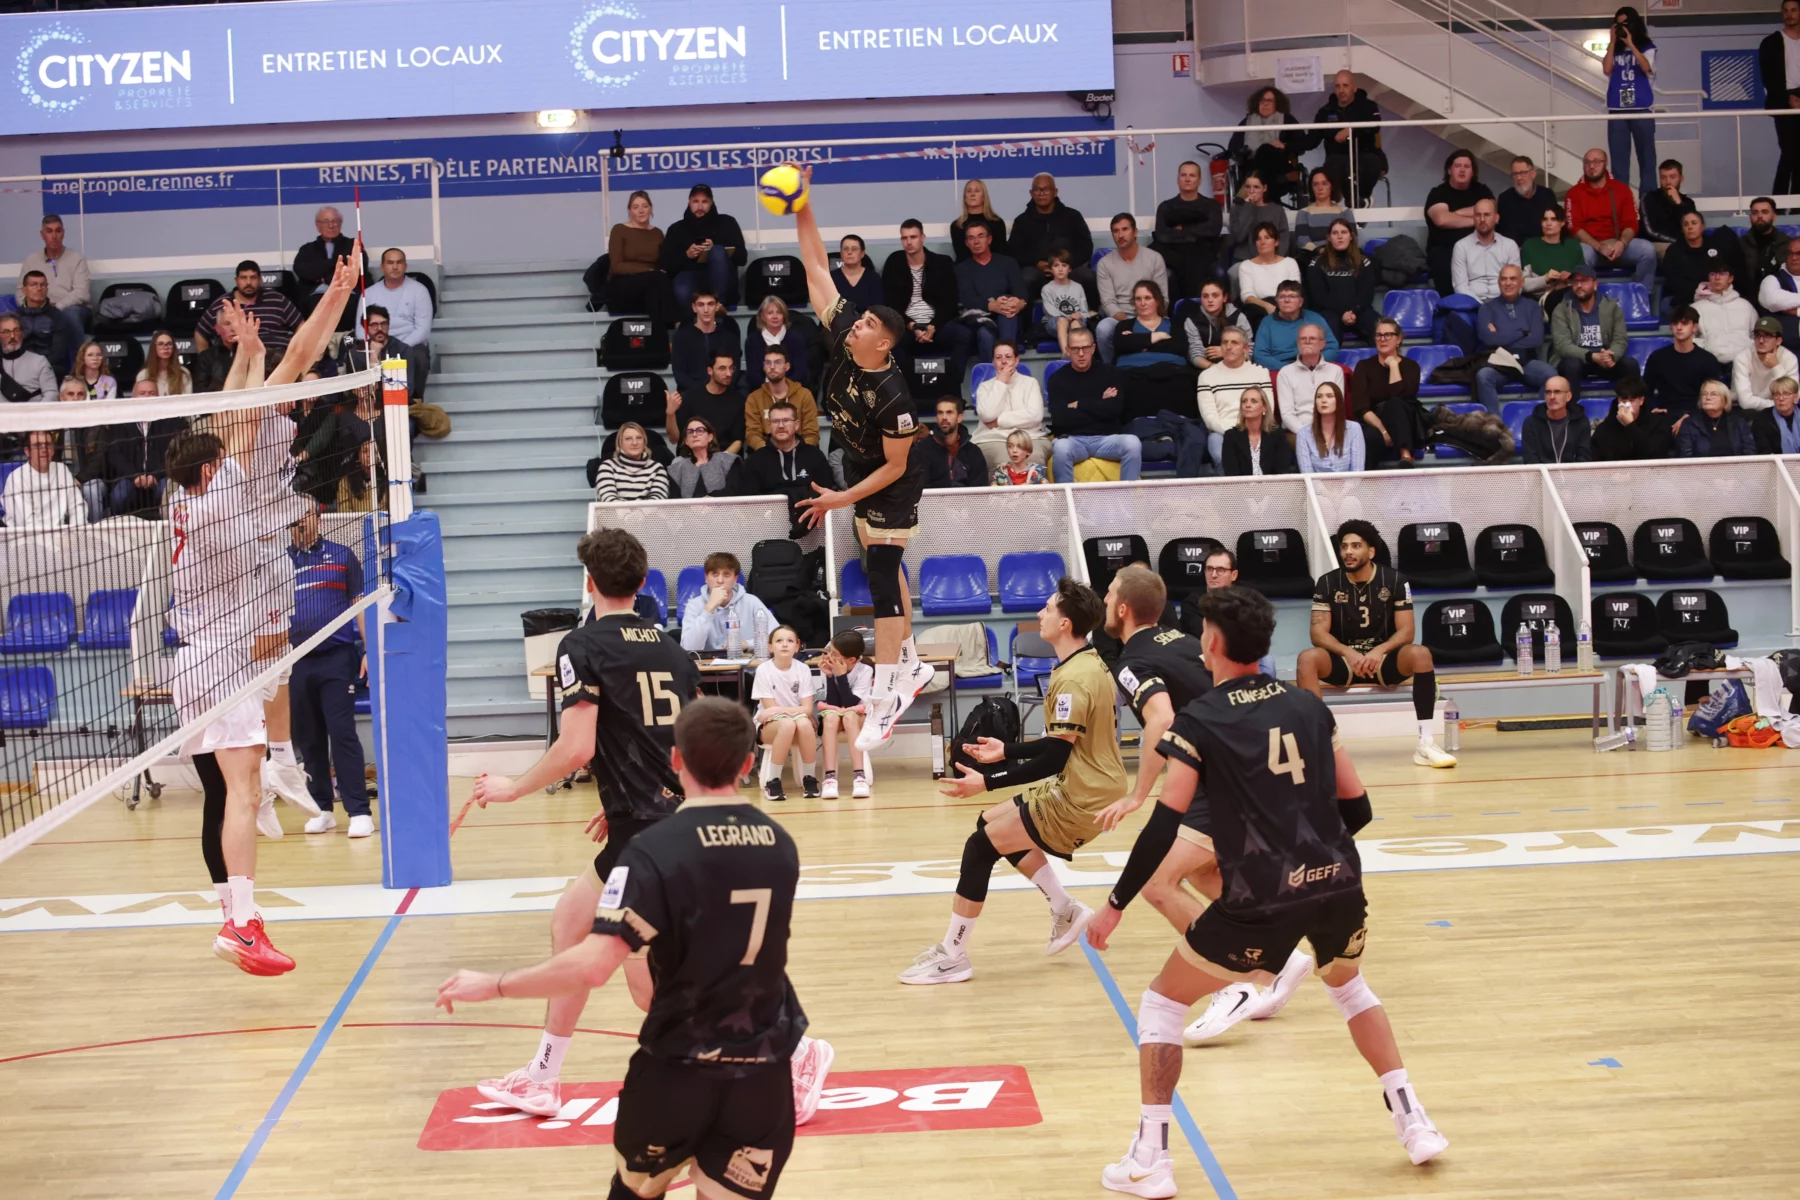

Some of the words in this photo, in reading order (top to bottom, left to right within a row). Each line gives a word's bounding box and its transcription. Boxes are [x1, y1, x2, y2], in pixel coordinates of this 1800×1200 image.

[818, 28, 943, 51] ENTRETIEN
[952, 23, 1059, 46] LOCAUX
[592, 25, 746, 64] CITYZEN
[262, 49, 387, 74] ENTRETIEN
[397, 44, 503, 68] LOCAUX
[38, 50, 192, 89] CITYZEN
[319, 163, 405, 184] RENNES,
[616, 153, 643, 172] DE
[647, 151, 702, 170] TOUS
[706, 149, 746, 169] LES
[746, 147, 822, 167] SPORTS
[769, 263, 783, 272] VIP
[261, 275, 276, 284] VIP
[188, 288, 203, 297] VIP
[630, 324, 645, 333] VIP
[106, 344, 121, 353] VIP
[176, 341, 190, 350] VIP
[921, 361, 937, 370] VIP
[628, 380, 643, 389] VIP
[1424, 528, 1440, 537] VIP
[1658, 528, 1674, 537] VIP
[1733, 526, 1749, 535] VIP
[1262, 535, 1279, 545] VIP
[1499, 535, 1515, 544] VIP
[1583, 531, 1599, 541] VIP
[172, 528, 187, 565] 7
[1106, 542, 1122, 551] VIP
[1185, 548, 1202, 557] VIP
[1680, 596, 1697, 606] VIP
[1529, 605, 1546, 614] VIP
[1612, 603, 1629, 612] VIP
[1358, 605, 1371, 628] 3
[1448, 609, 1465, 618] VIP
[619, 626, 661, 644] MICHOT
[1227, 680, 1287, 706] FONSECA
[636, 671, 682, 726] 15
[1267, 726, 1306, 785] 4
[696, 824, 776, 848] LEGRAND
[1306, 863, 1341, 883] GEFF
[730, 888, 772, 966] 7
[543, 1043, 552, 1063] CRAFT
[452, 1079, 1005, 1130] Belic
